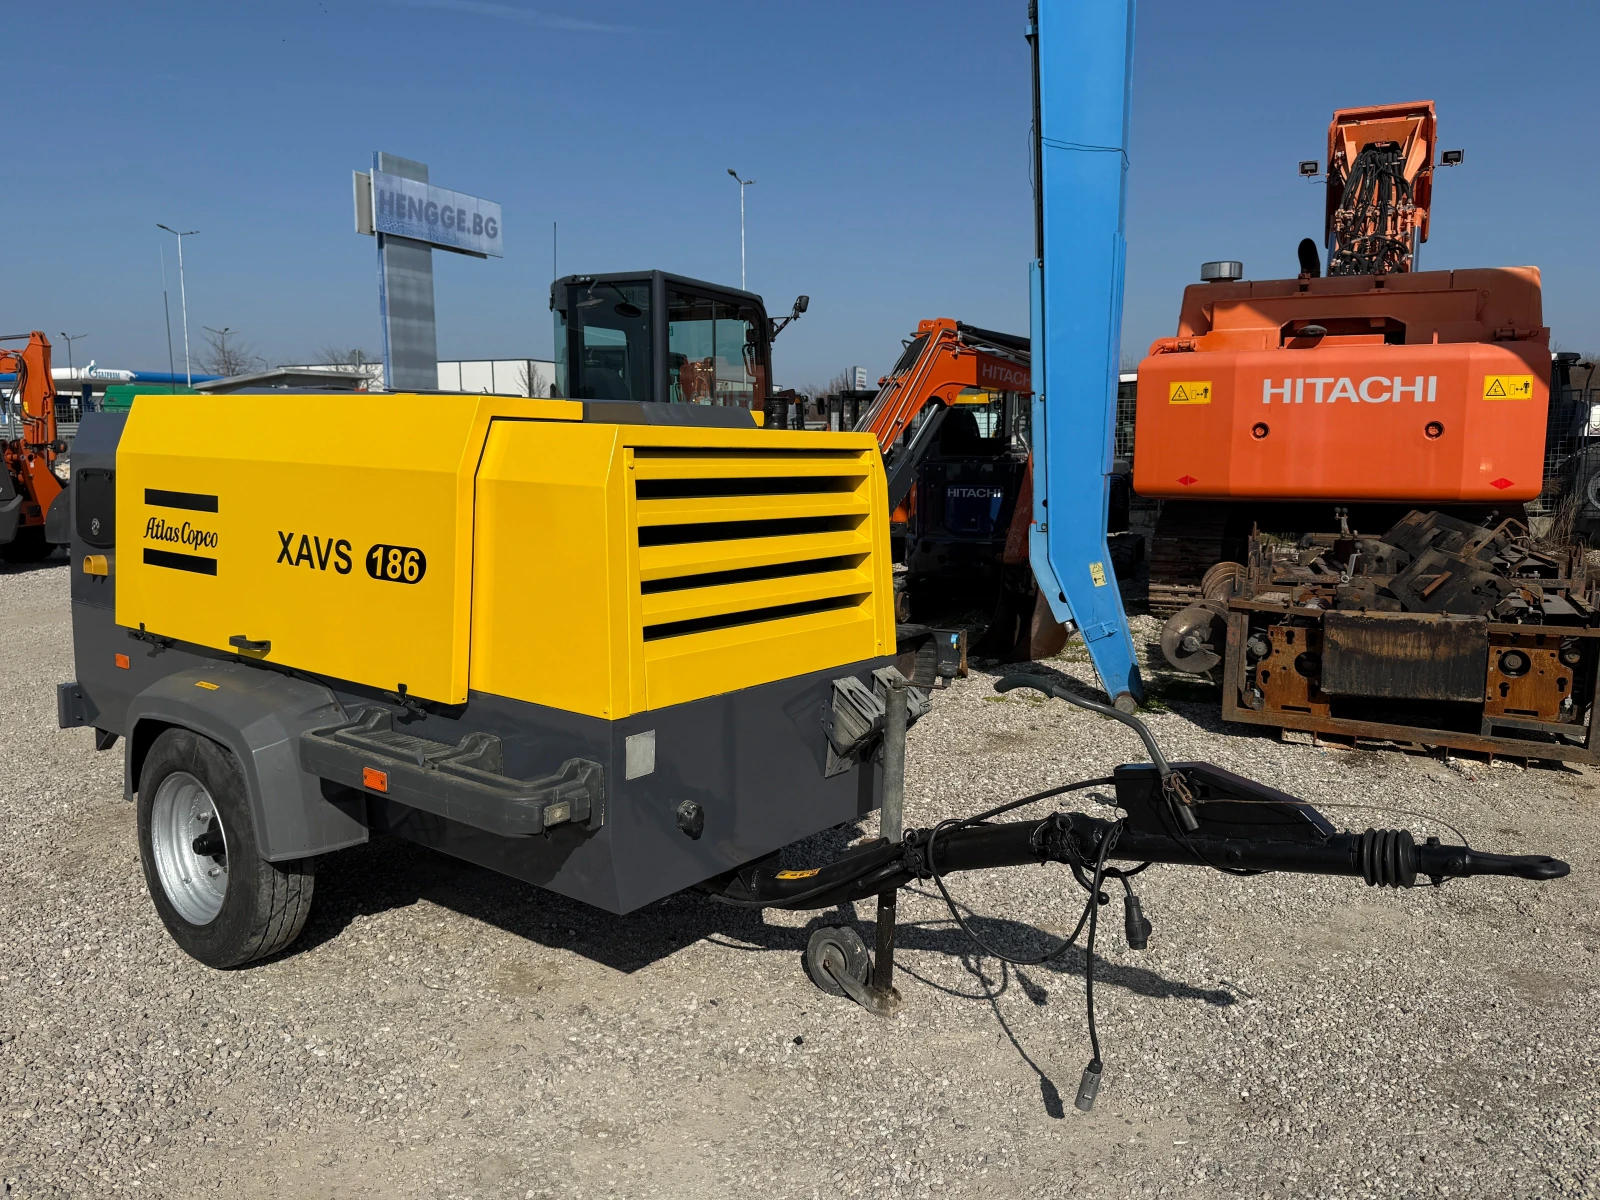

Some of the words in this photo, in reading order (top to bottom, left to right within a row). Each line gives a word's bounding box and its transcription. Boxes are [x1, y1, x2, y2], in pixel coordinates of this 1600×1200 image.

[379, 189, 498, 239] HENGGE.BG
[982, 363, 1031, 387] HITACH
[1262, 375, 1438, 404] HITACHI
[947, 488, 1001, 498] HITACHI
[143, 516, 180, 543] Atlas
[181, 521, 219, 551] Copco
[276, 530, 353, 575] XAVS
[372, 546, 420, 582] 186
